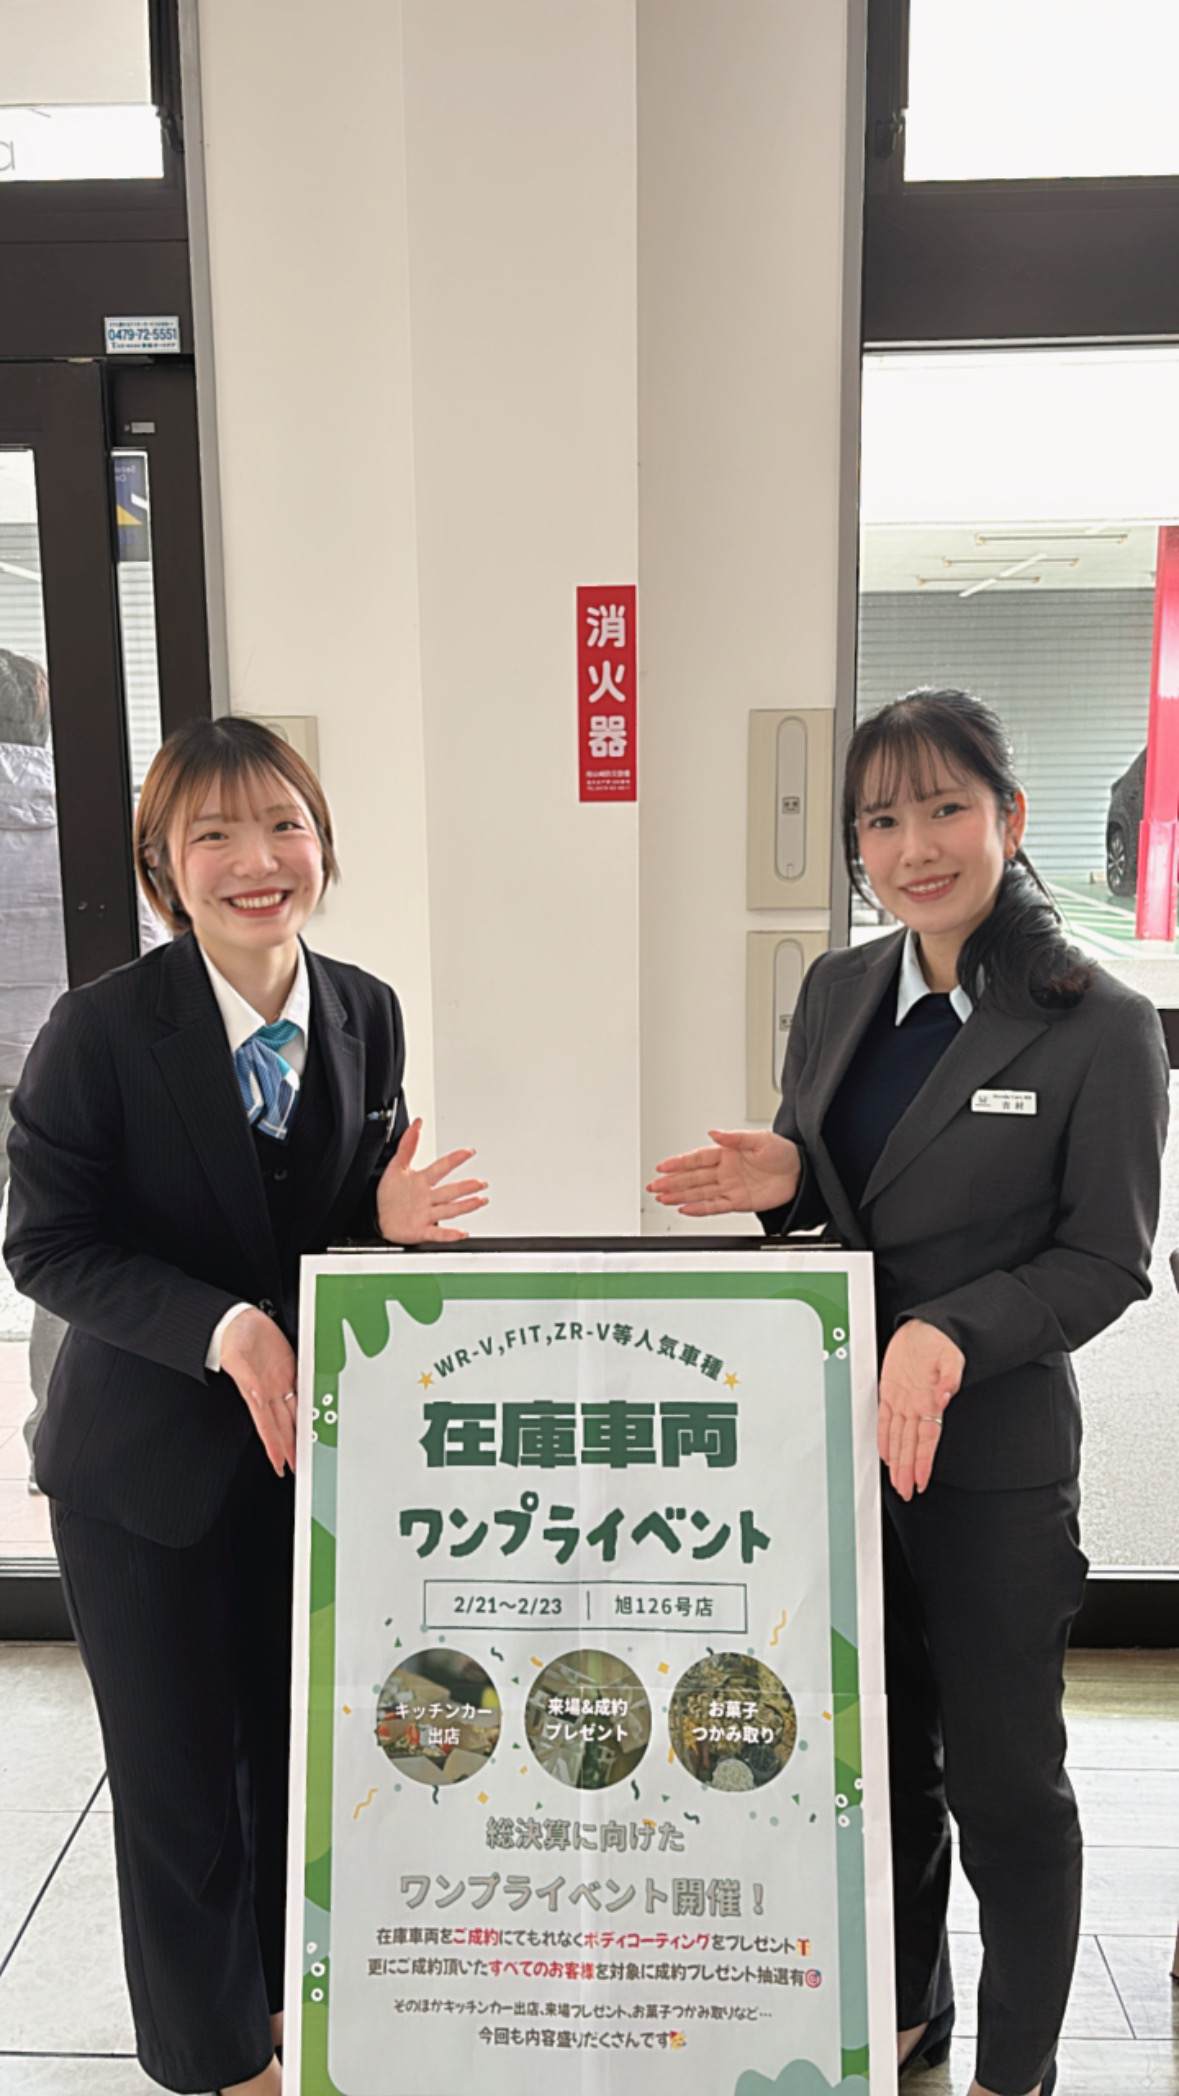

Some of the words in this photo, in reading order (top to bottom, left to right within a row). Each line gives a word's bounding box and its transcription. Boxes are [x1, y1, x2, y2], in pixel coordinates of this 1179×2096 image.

[108, 328, 178, 341] 0479-72-5551
[586, 603, 628, 758] 消火器
[419, 1400, 738, 1468] 在庫車両
[400, 1490, 771, 1564] ワンプライベント
[615, 1595, 714, 1618] 旭126号店
[395, 1702, 493, 1720] キッチンカー
[547, 1697, 628, 1718] 来場&成約
[708, 1701, 759, 1720] お菓子
[428, 1727, 460, 1746] 出店
[546, 1724, 628, 1742] プレゼント
[692, 1726, 774, 1744] つかみ取り
[486, 1816, 685, 1853] 総決算に向けた
[478, 2026, 670, 2049] 今回も内容盛りだくさんです
